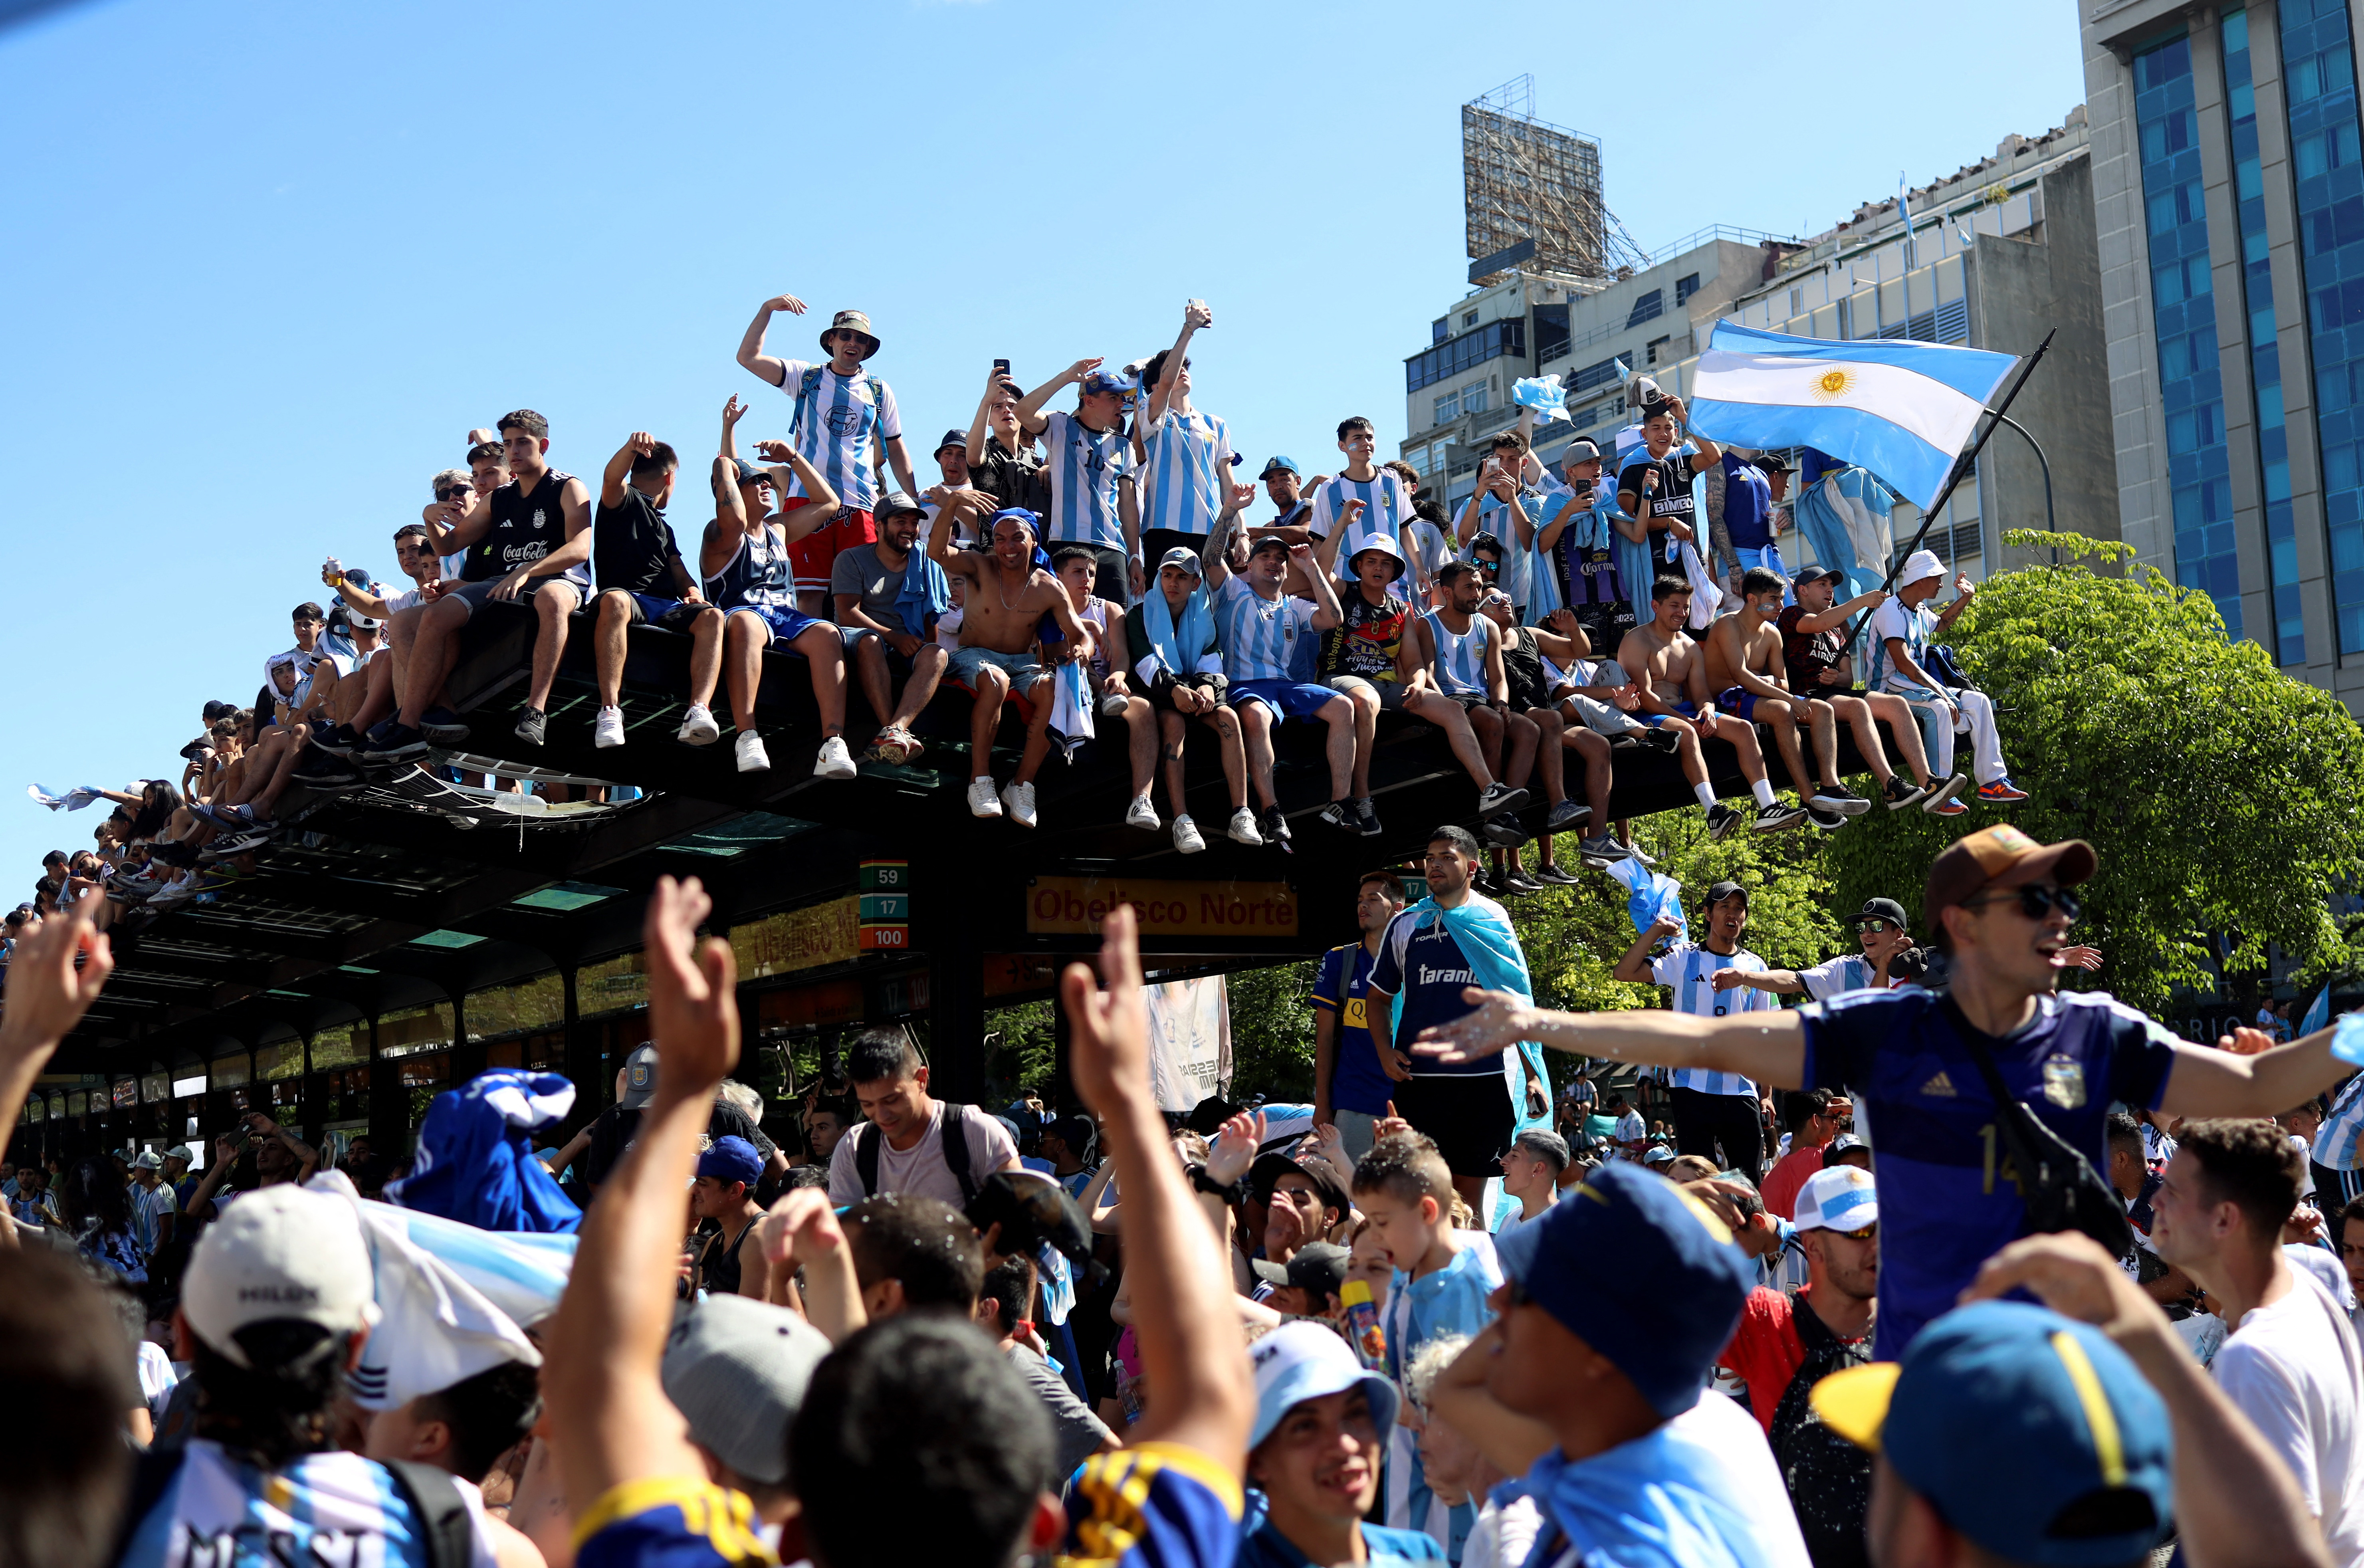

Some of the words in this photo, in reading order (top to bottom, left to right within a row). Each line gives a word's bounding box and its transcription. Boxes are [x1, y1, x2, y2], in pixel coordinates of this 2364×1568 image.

[1084, 448, 1106, 472] 10
[1654, 497, 1694, 514] BIMBO
[503, 540, 548, 562] Coca-Cola
[765, 567, 776, 584] 7
[1614, 613, 1635, 624] 2022
[879, 870, 898, 884] 59
[1406, 882, 1420, 895] 17
[880, 900, 897, 914] 17
[1034, 888, 1187, 924] Obelsco
[1200, 893, 1294, 926] Norte
[875, 930, 902, 945] 100
[1415, 932, 1449, 943] TOPER
[885, 982, 899, 1011] 17
[83, 1074, 96, 1082] 59
